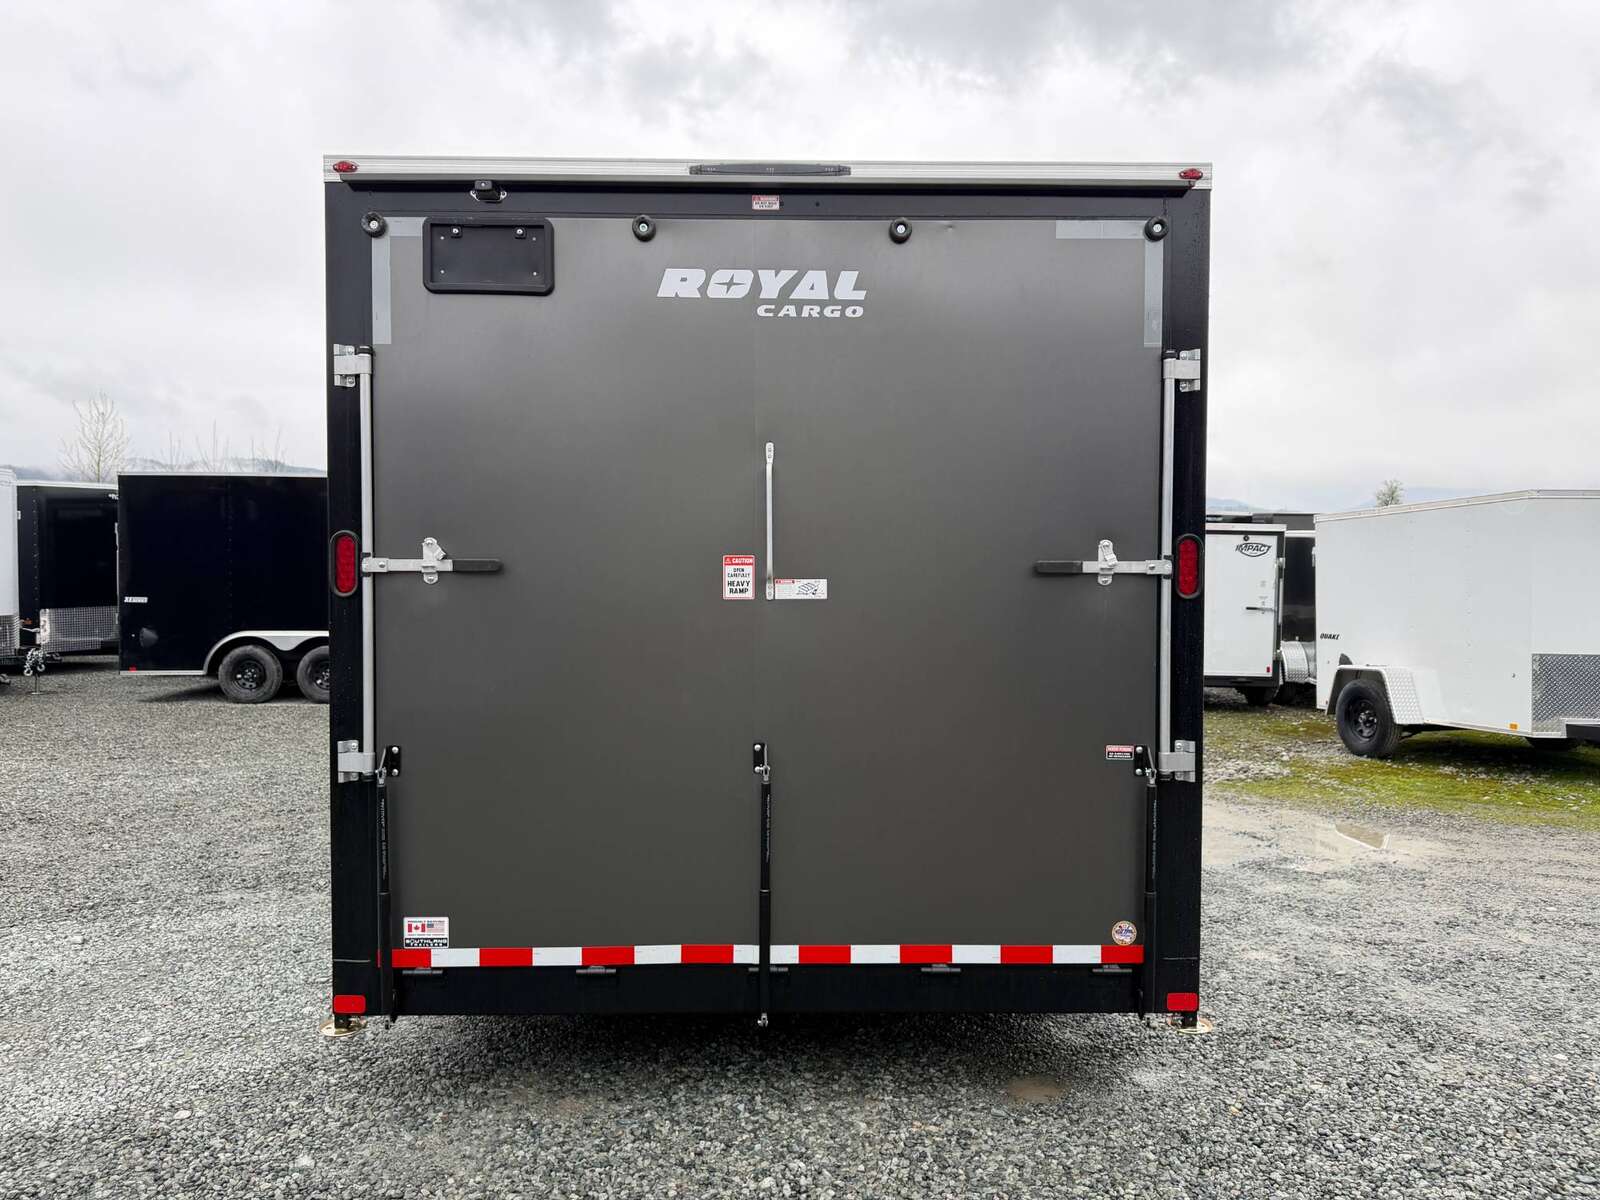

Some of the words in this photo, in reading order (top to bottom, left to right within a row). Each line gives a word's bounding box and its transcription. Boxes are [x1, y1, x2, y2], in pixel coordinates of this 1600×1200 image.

[656, 267, 867, 300] ROYAL
[756, 304, 866, 318] CARGO
[1235, 543, 1272, 553] IMPACT
